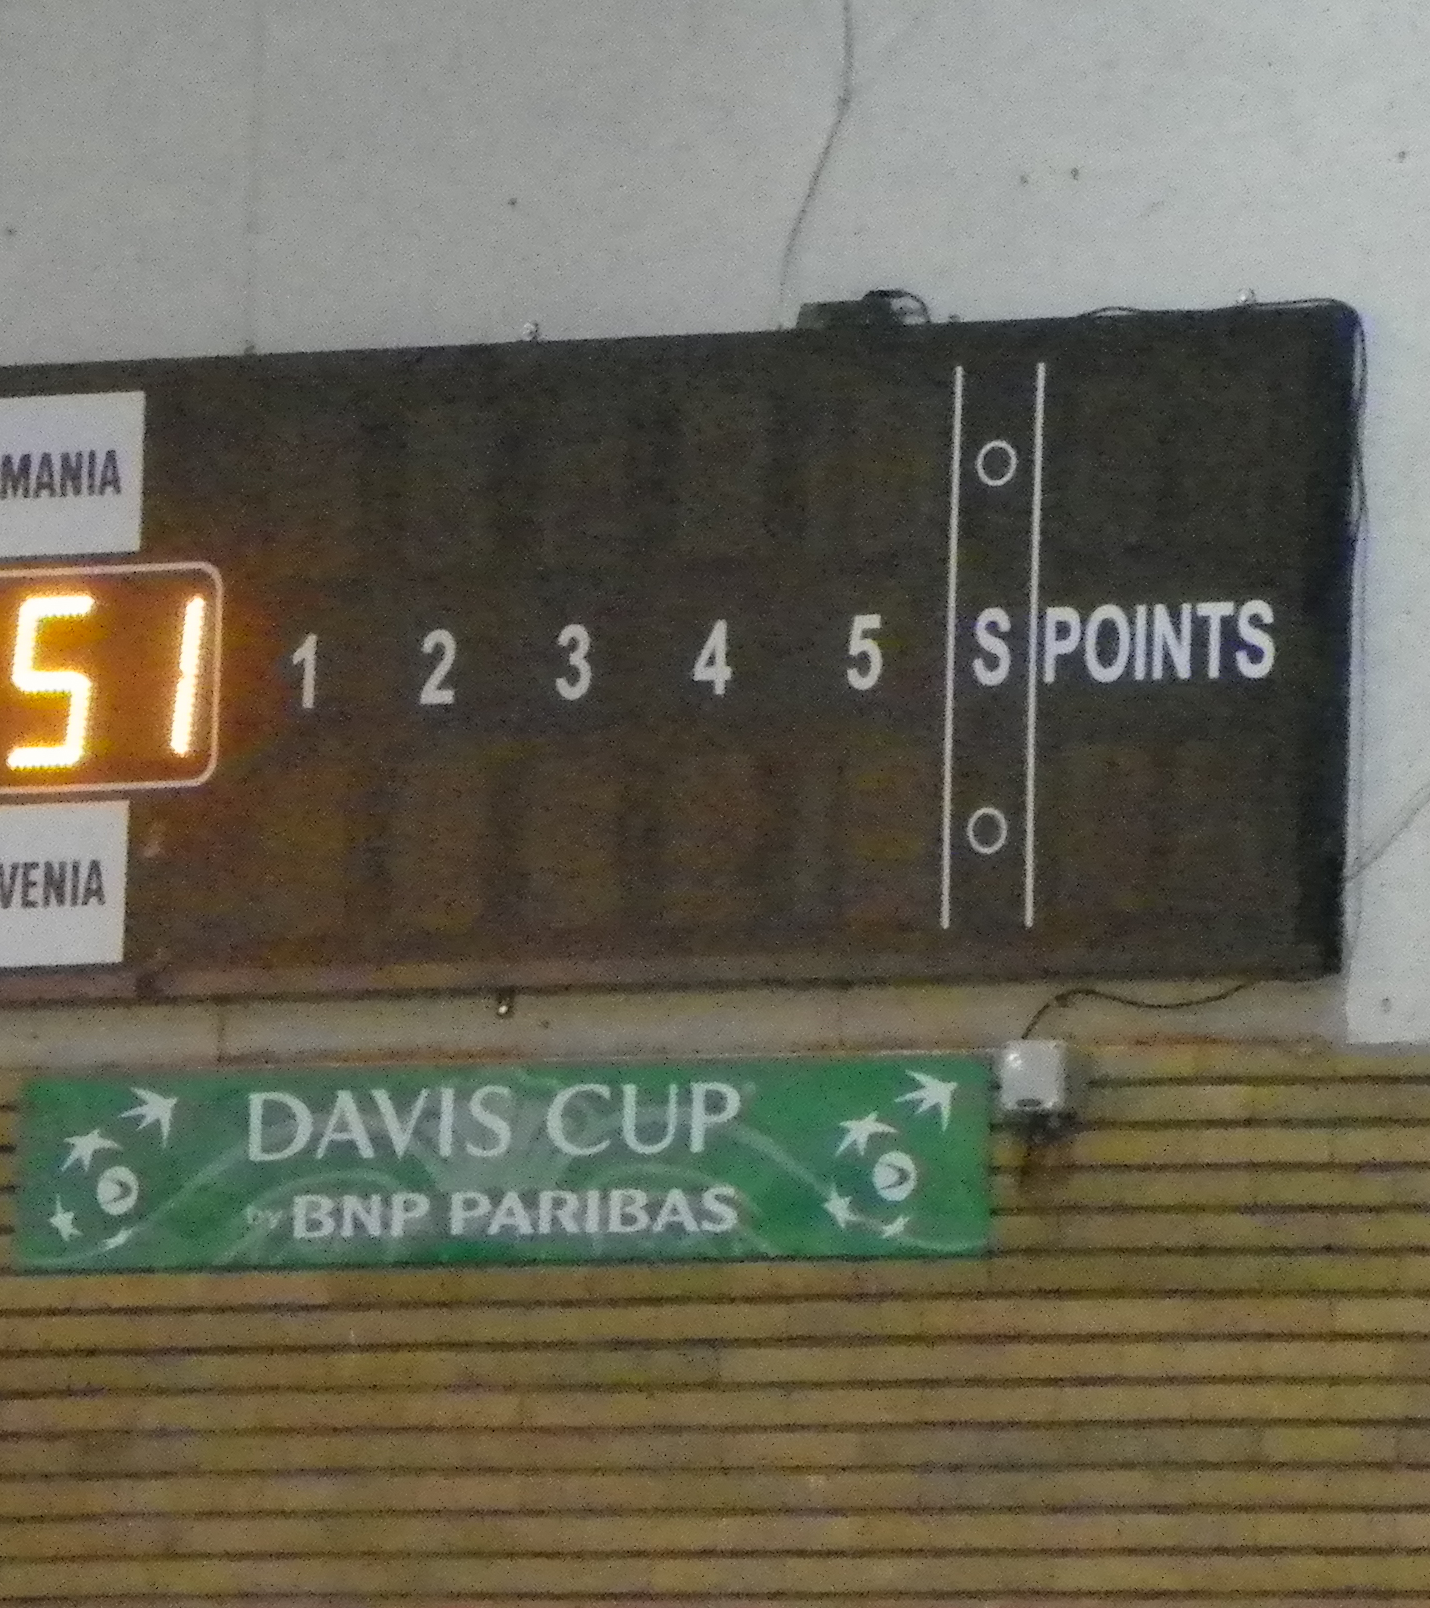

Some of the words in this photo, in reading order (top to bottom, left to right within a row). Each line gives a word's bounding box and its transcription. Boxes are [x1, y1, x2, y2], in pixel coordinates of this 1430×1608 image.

[291, 633, 318, 709] 1
[419, 628, 456, 705] 2
[555, 623, 593, 701] 3
[692, 619, 732, 696] 4
[845, 613, 884, 691] 5
[972, 606, 1012, 687] S
[1042, 598, 1276, 685] POINTS
[247, 1084, 513, 1162] DAVIS
[545, 1081, 742, 1156] CUP
[292, 1191, 431, 1240] BNP
[449, 1183, 740, 1236] PARIBAS
